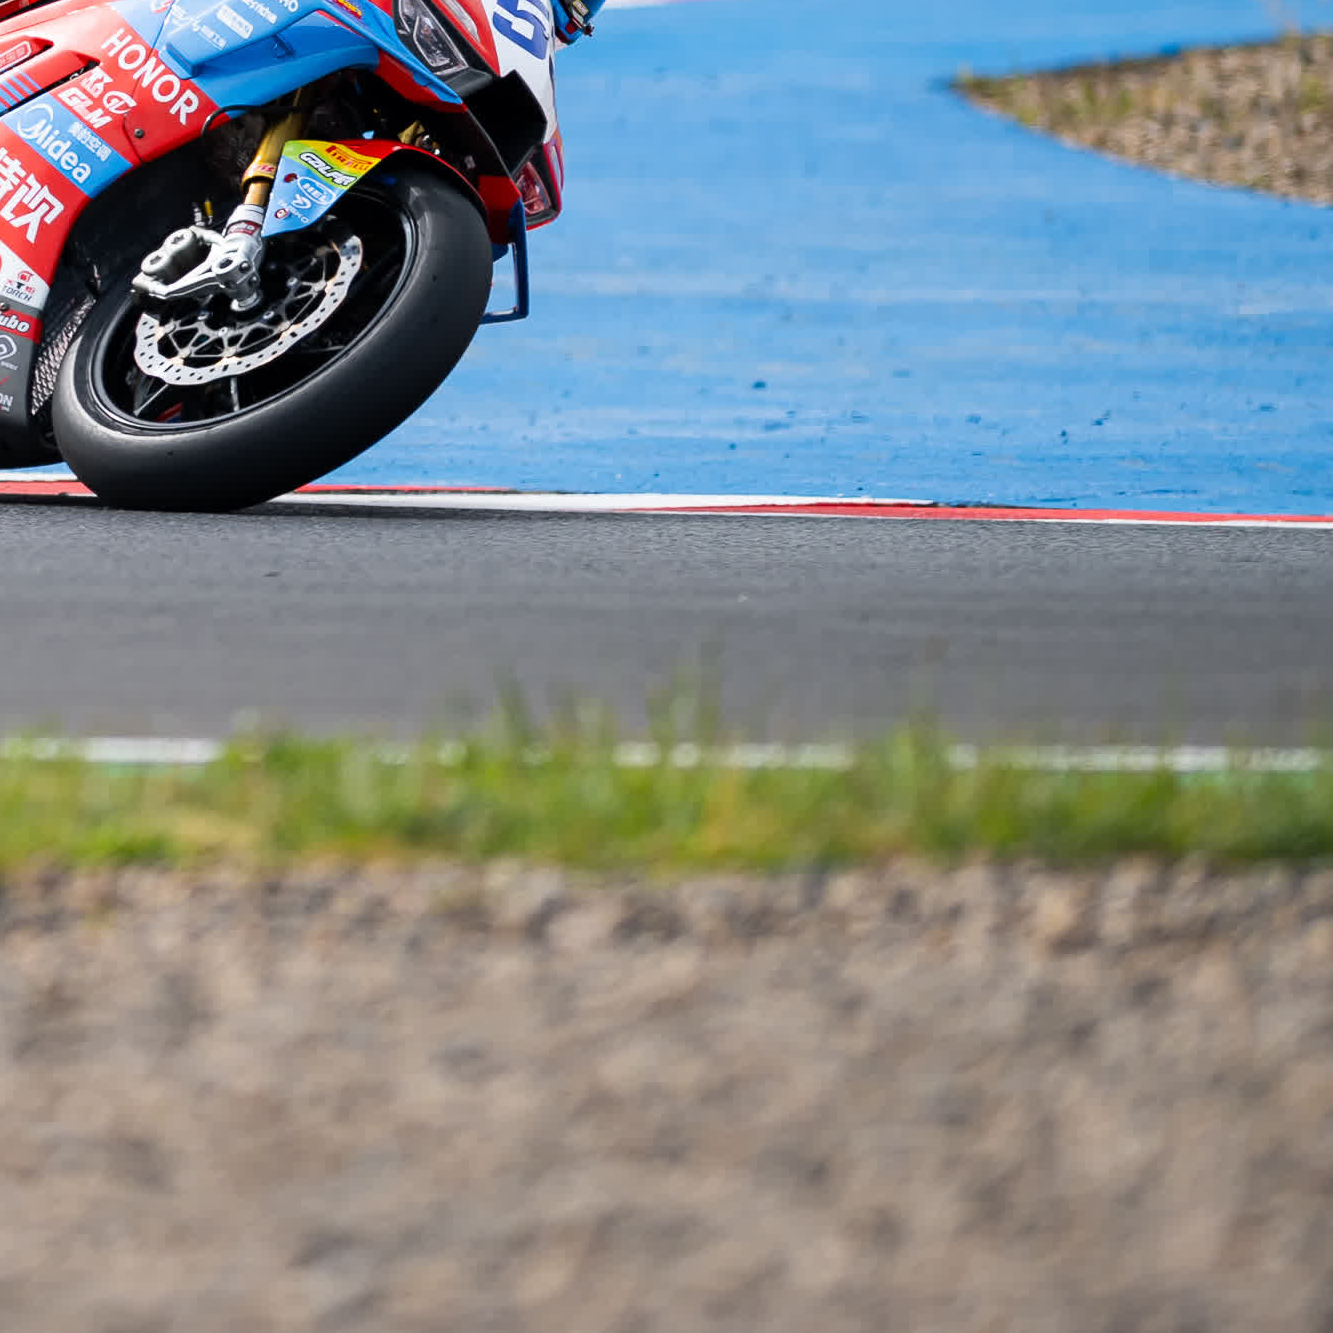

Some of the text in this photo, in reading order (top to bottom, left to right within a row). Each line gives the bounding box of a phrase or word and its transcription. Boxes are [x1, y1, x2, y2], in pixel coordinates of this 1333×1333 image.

[101, 27, 199, 125] HONOR
[30, 118, 92, 184] Midea
[2, 286, 33, 302] TORCH
